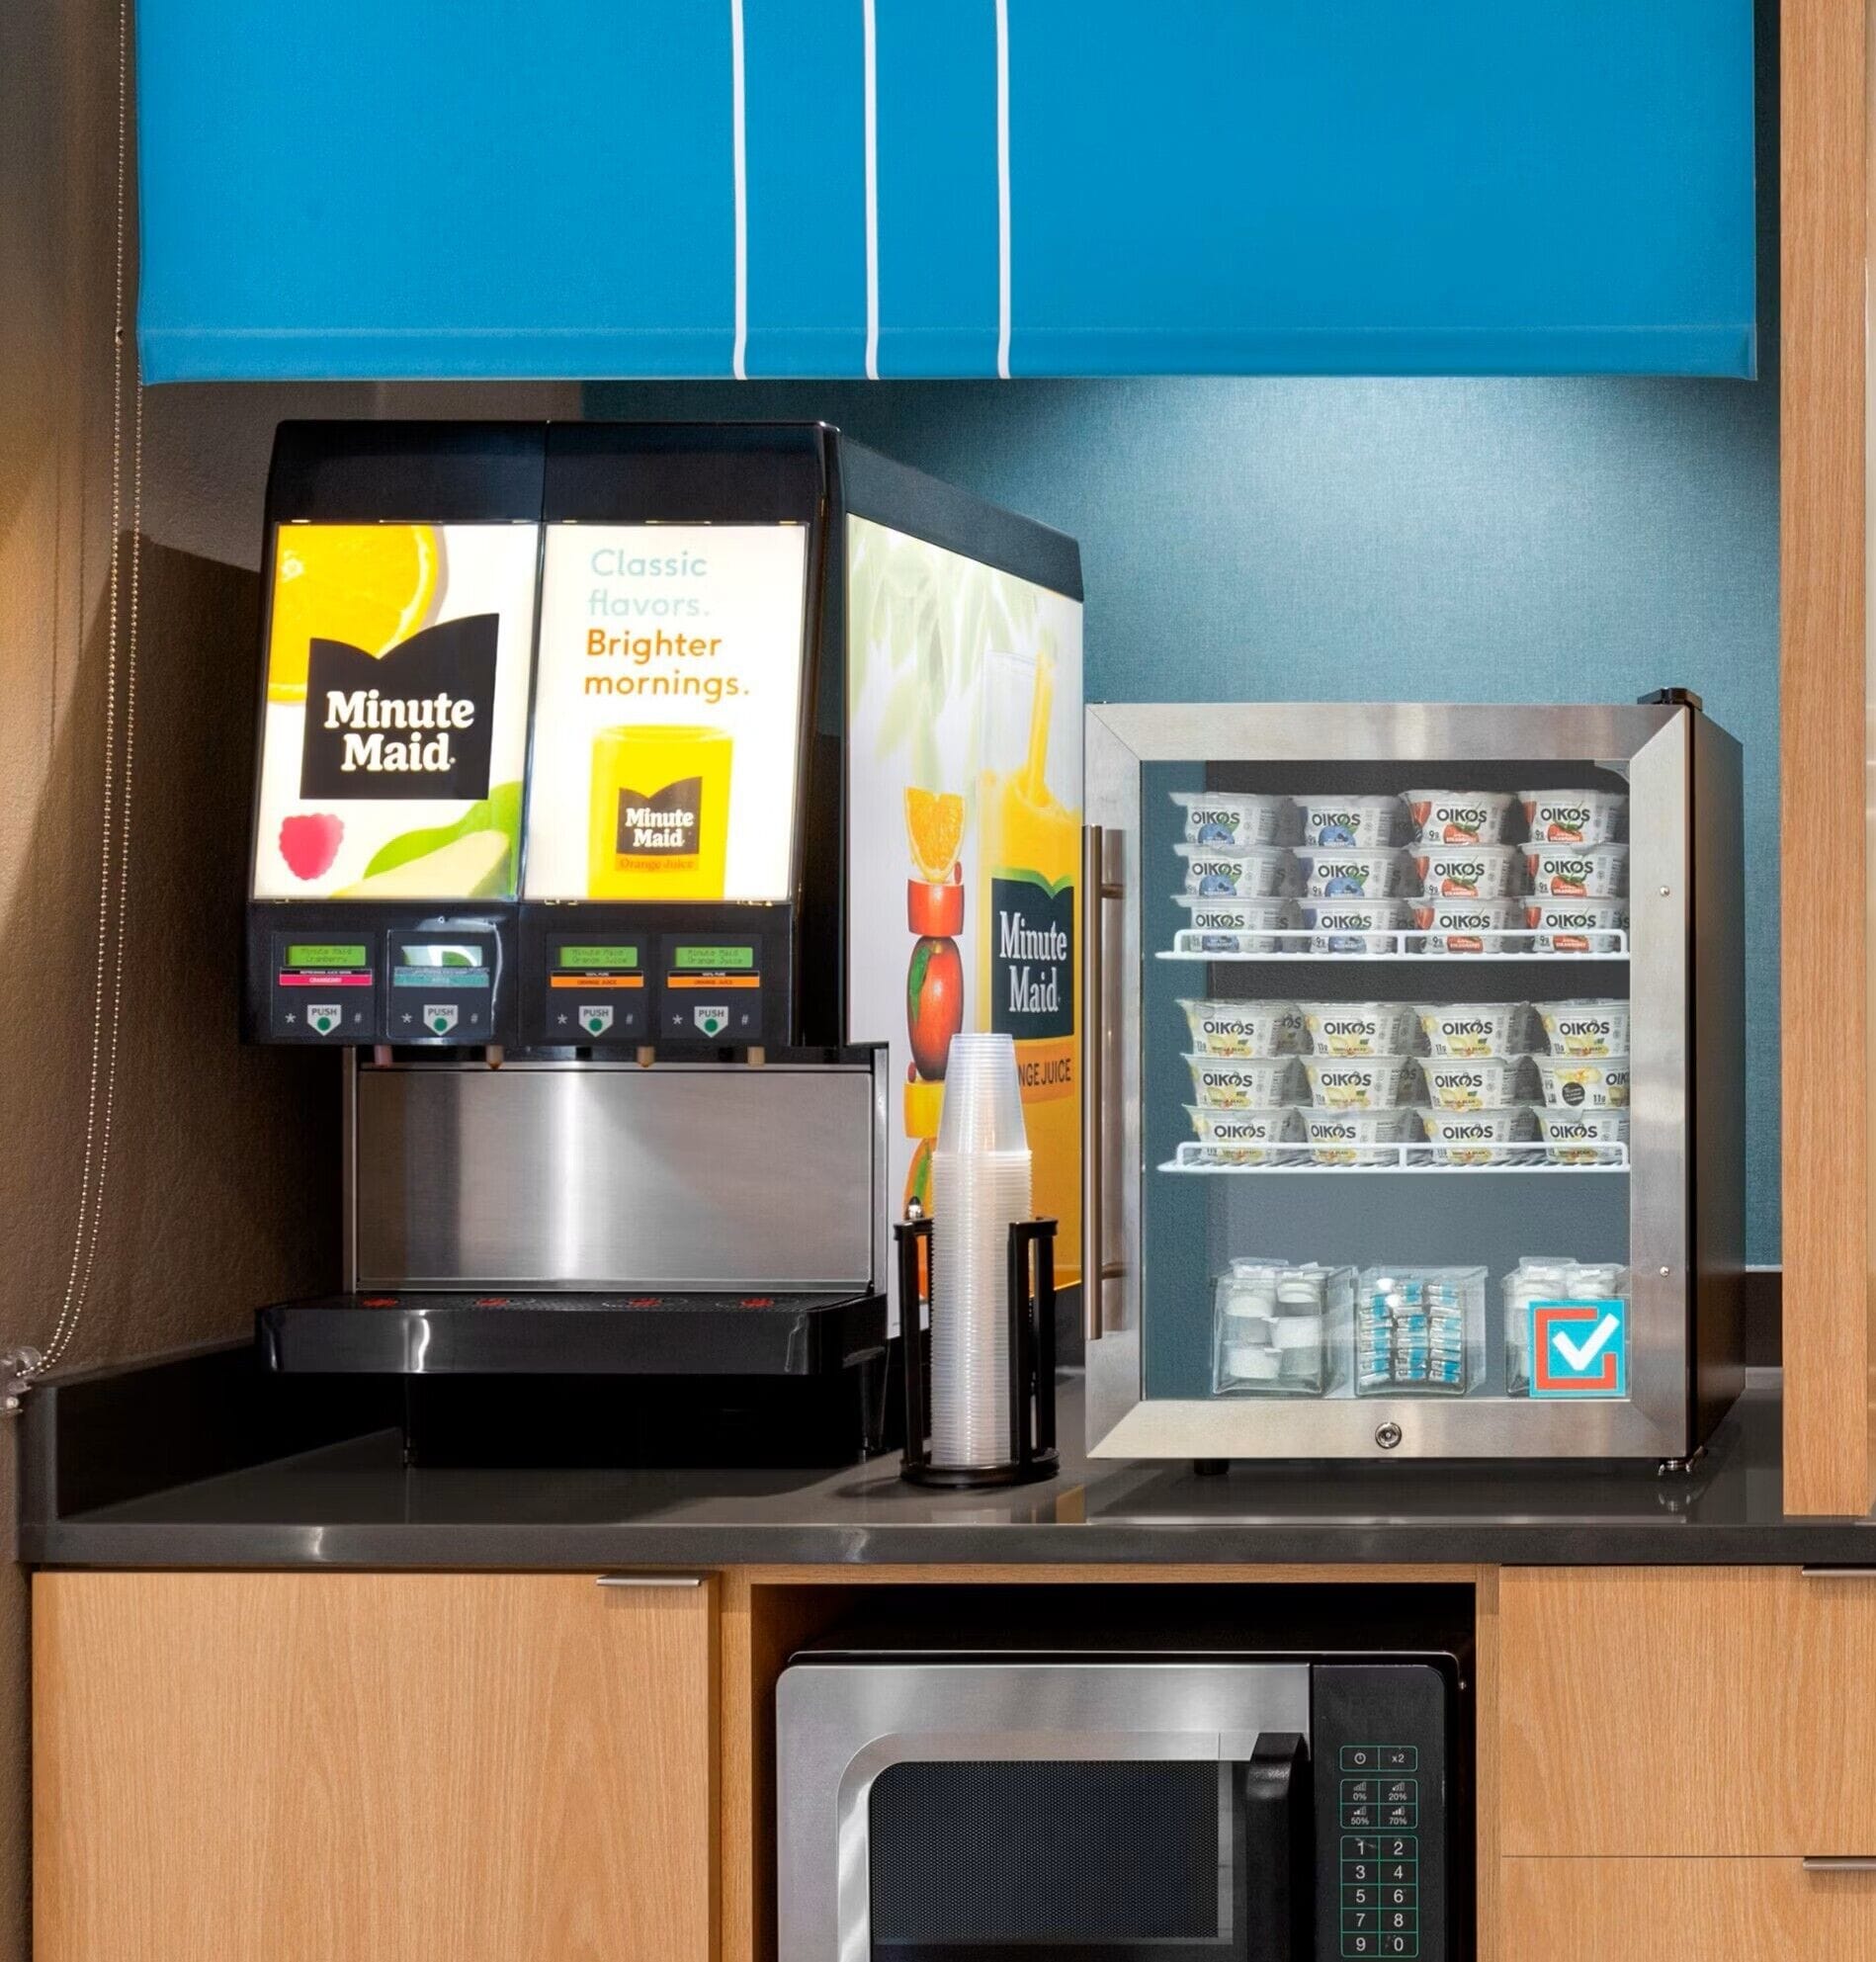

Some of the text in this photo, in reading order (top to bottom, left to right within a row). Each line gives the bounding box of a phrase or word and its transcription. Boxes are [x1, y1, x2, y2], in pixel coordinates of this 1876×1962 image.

[591, 549, 708, 576] Classic
[588, 589, 711, 616] flavors.
[587, 629, 723, 665] Brighter
[584, 669, 749, 704] mornings.
[324, 689, 475, 728] Minute
[340, 731, 452, 771] Maid
[625, 807, 694, 827] Minute
[1191, 811, 1240, 824] OIKOS
[1312, 813, 1361, 826] OIKOS
[1436, 809, 1487, 822] OIKOS
[1540, 808, 1590, 821] OIKOS
[633, 827, 684, 847] Maid
[1192, 863, 1242, 876] OIKOS
[1318, 865, 1370, 878] OIKOS
[1434, 863, 1486, 877] OIKOS
[1544, 861, 1593, 874] OIKOS
[1195, 914, 1245, 927] OIKOS
[1322, 915, 1372, 929] OIKOS
[1440, 915, 1491, 928] OIKOS
[1546, 914, 1596, 927] OIKOS
[999, 910, 1067, 962] Minute
[1008, 965, 1060, 1012] Maid
[1203, 1021, 1254, 1035] OIKOS
[1323, 1021, 1376, 1035] OIKOS
[1442, 1020, 1492, 1035] OIKOS
[1560, 1020, 1610, 1035] OIKOS
[1041, 1059, 1071, 1085] JUICE
[1203, 1072, 1253, 1086] OIKOS
[1322, 1072, 1372, 1086] OIKOS
[1434, 1072, 1483, 1087] OIKOS
[1214, 1124, 1266, 1138] OIKOS
[1312, 1124, 1356, 1139] OIKOS
[1443, 1125, 1493, 1139] OIKOS
[1550, 1124, 1598, 1139] OIKOS
[1392, 1754, 1405, 1763] x2
[1351, 1817, 1370, 1826] 50%
[1389, 1817, 1407, 1826] 70%
[1357, 1841, 1365, 1855] 1
[1394, 1841, 1404, 1855] 2
[1356, 1865, 1366, 1879] 3
[1394, 1865, 1404, 1879] 4
[1356, 1889, 1366, 1903] 5
[1394, 1889, 1404, 1903] 6
[1356, 1914, 1366, 1927] 7
[1394, 1914, 1404, 1927] 8
[1356, 1937, 1366, 1951] 9
[1394, 1937, 1404, 1951] 0
